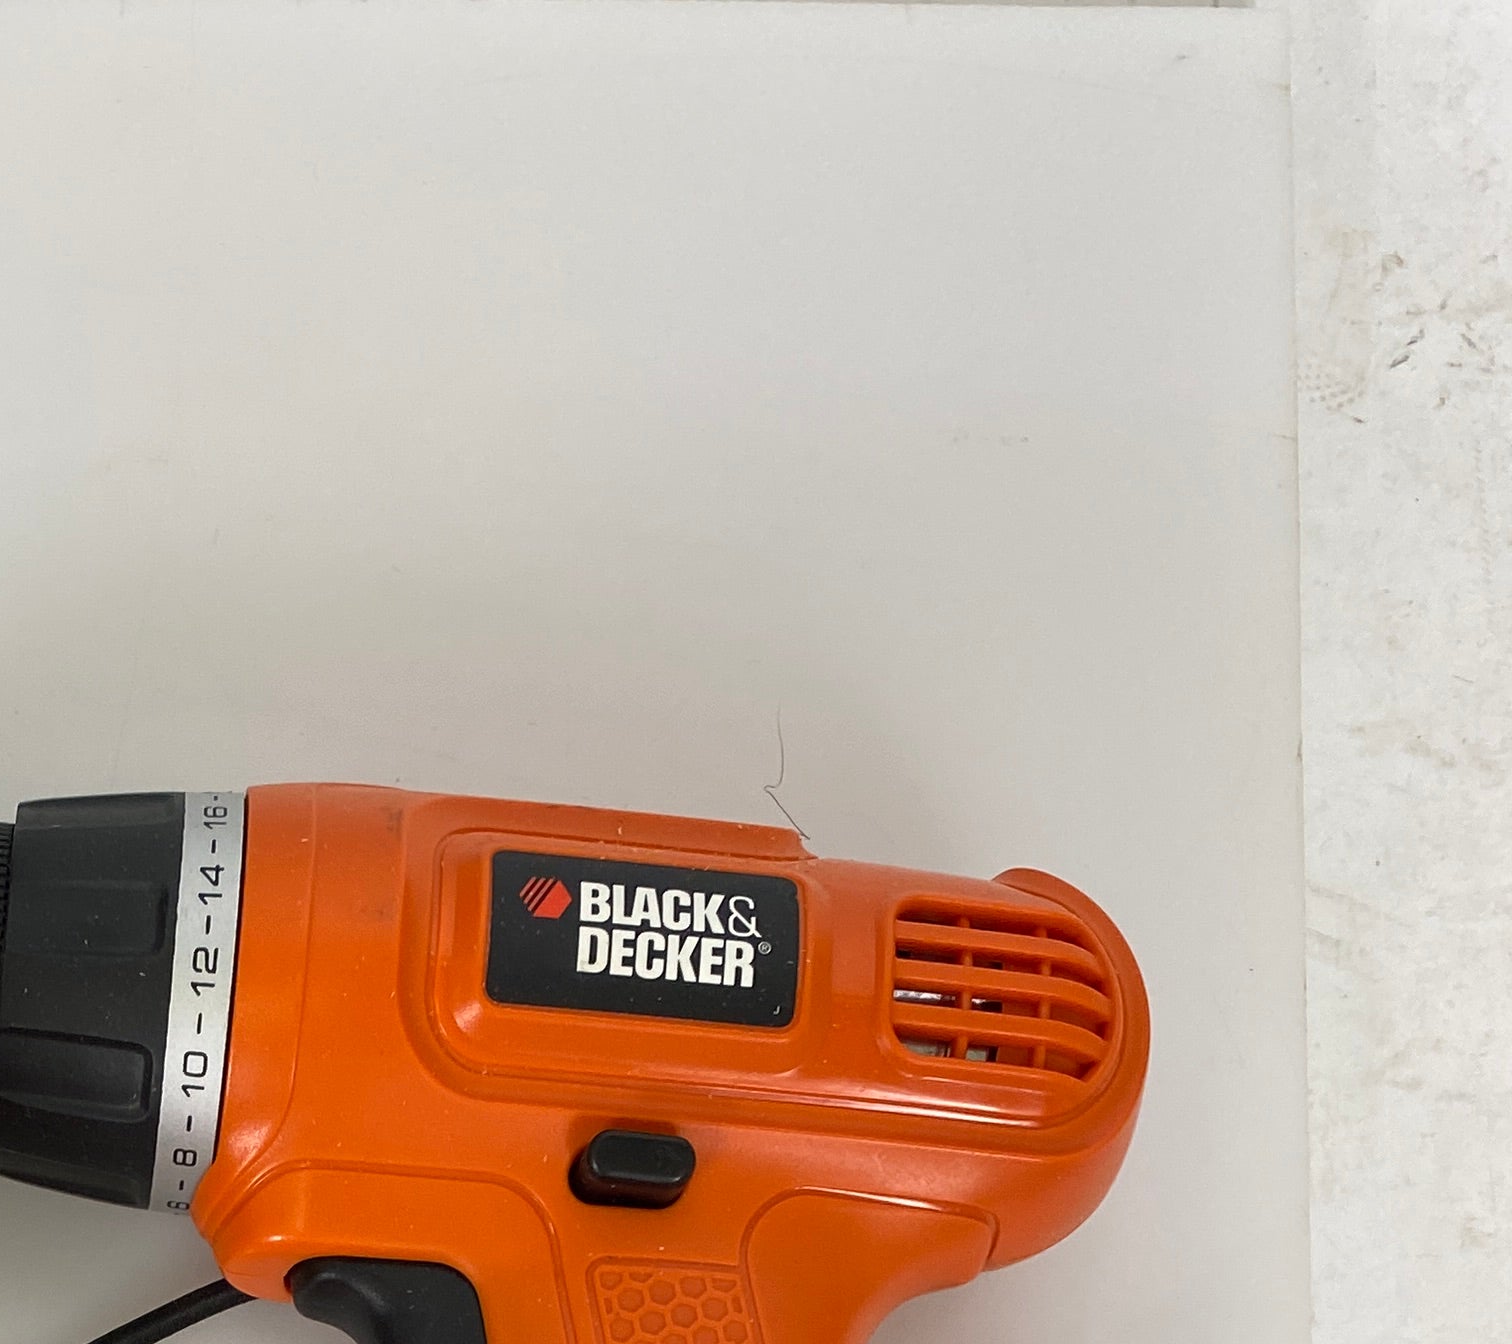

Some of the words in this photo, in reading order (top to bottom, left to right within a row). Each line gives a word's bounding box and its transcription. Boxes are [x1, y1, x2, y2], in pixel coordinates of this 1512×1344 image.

[198, 864, 225, 906] 14
[190, 946, 220, 996] 12
[181, 1050, 208, 1098] 10
